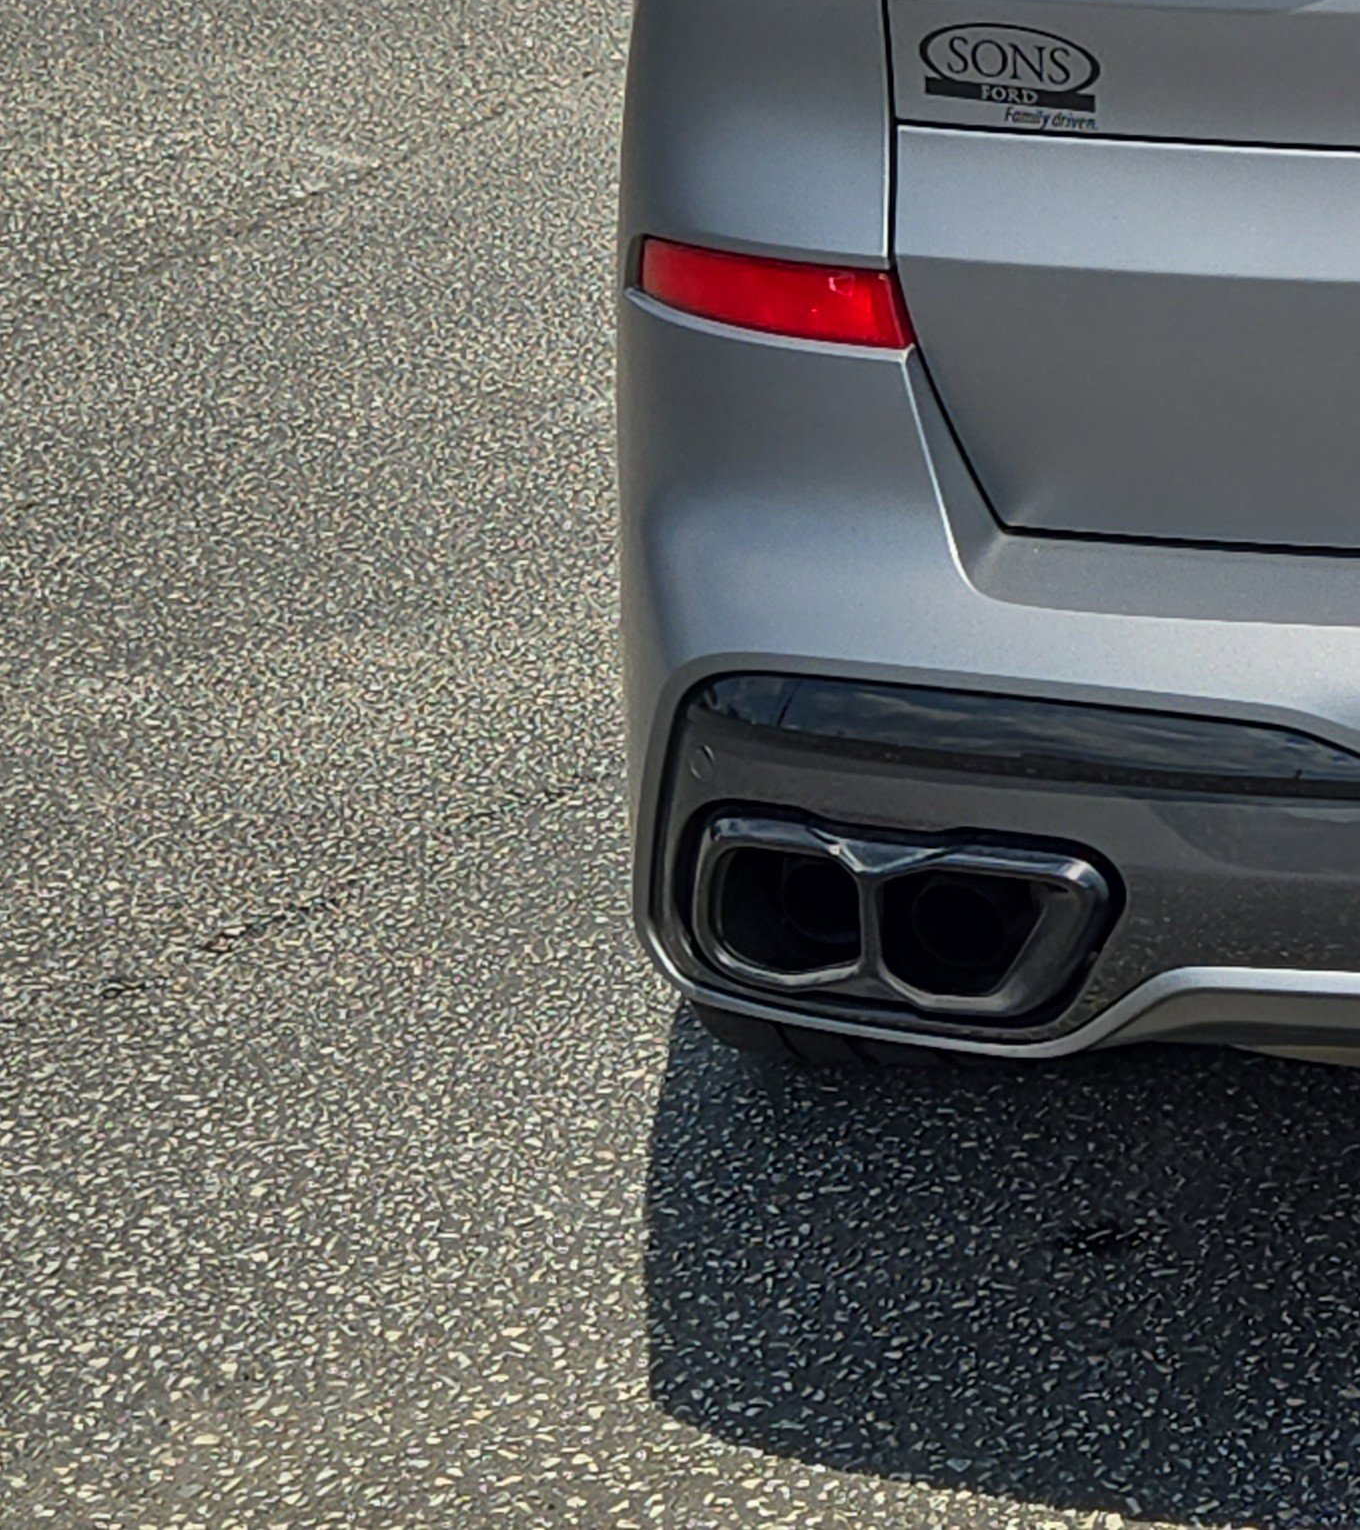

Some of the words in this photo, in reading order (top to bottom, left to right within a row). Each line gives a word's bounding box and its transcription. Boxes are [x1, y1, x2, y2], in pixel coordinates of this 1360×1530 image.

[947, 35, 1071, 86] SONS
[980, 84, 1040, 106] FORD
[1004, 106, 1050, 130] Family
